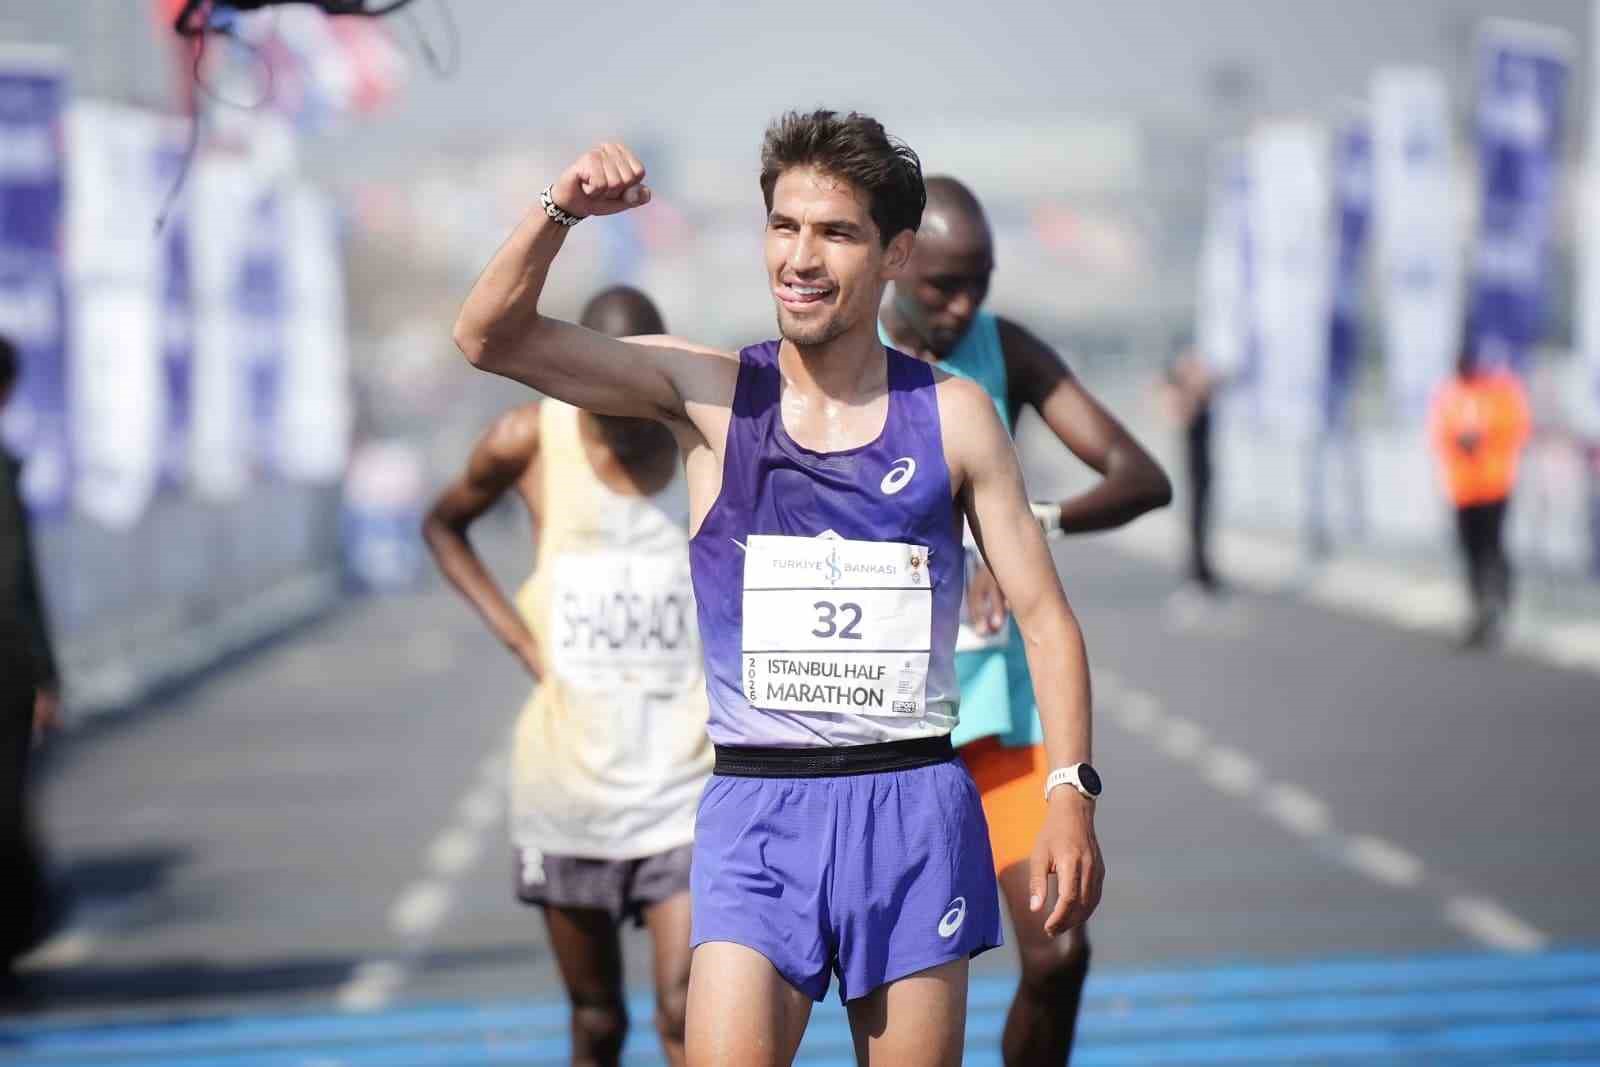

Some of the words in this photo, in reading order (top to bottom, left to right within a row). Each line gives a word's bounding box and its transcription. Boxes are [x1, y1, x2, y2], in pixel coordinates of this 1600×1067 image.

[811, 601, 862, 640] 32
[768, 659, 841, 678] ISTANBUL
[844, 663, 886, 680] HALF
[766, 681, 884, 706] MARATHON
